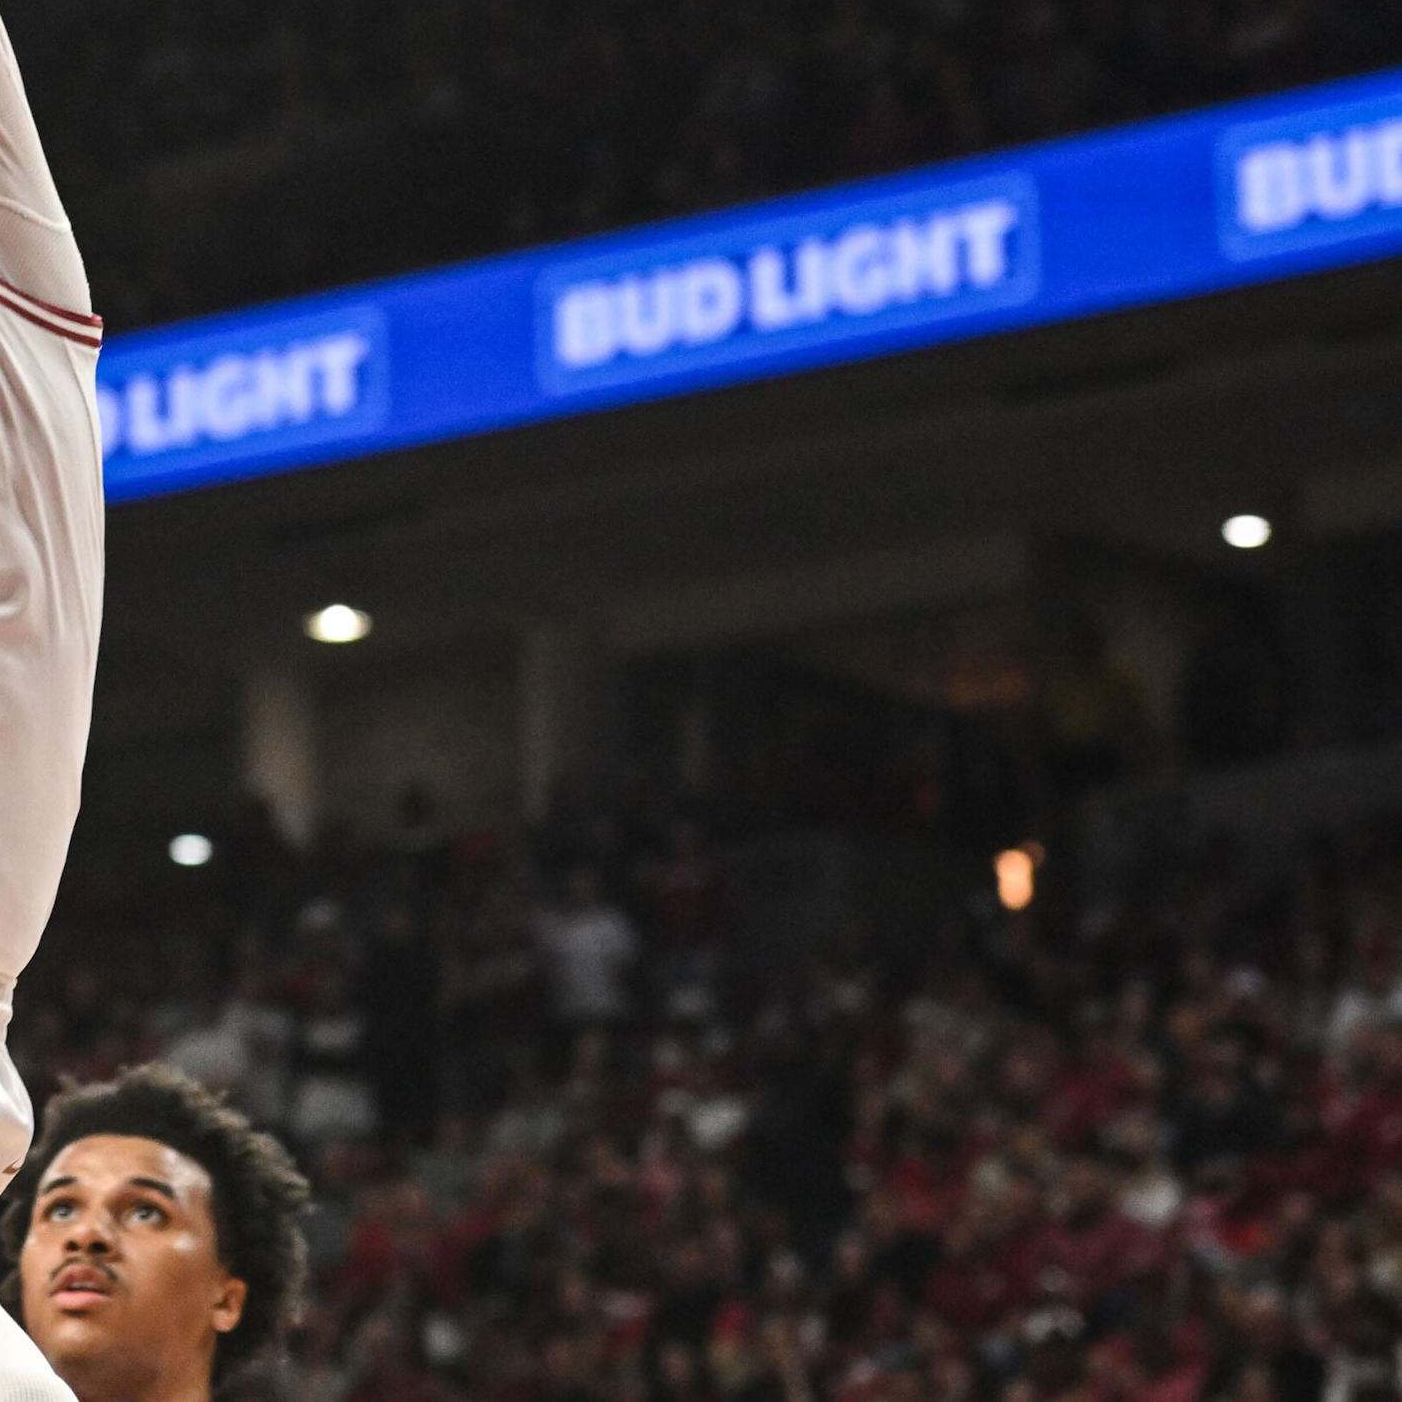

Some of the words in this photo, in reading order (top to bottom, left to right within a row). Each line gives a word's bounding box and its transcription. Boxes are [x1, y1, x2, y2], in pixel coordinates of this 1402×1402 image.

[555, 261, 742, 368] BUD
[749, 201, 1015, 328] LIGHT
[127, 334, 367, 455] LIGHT
